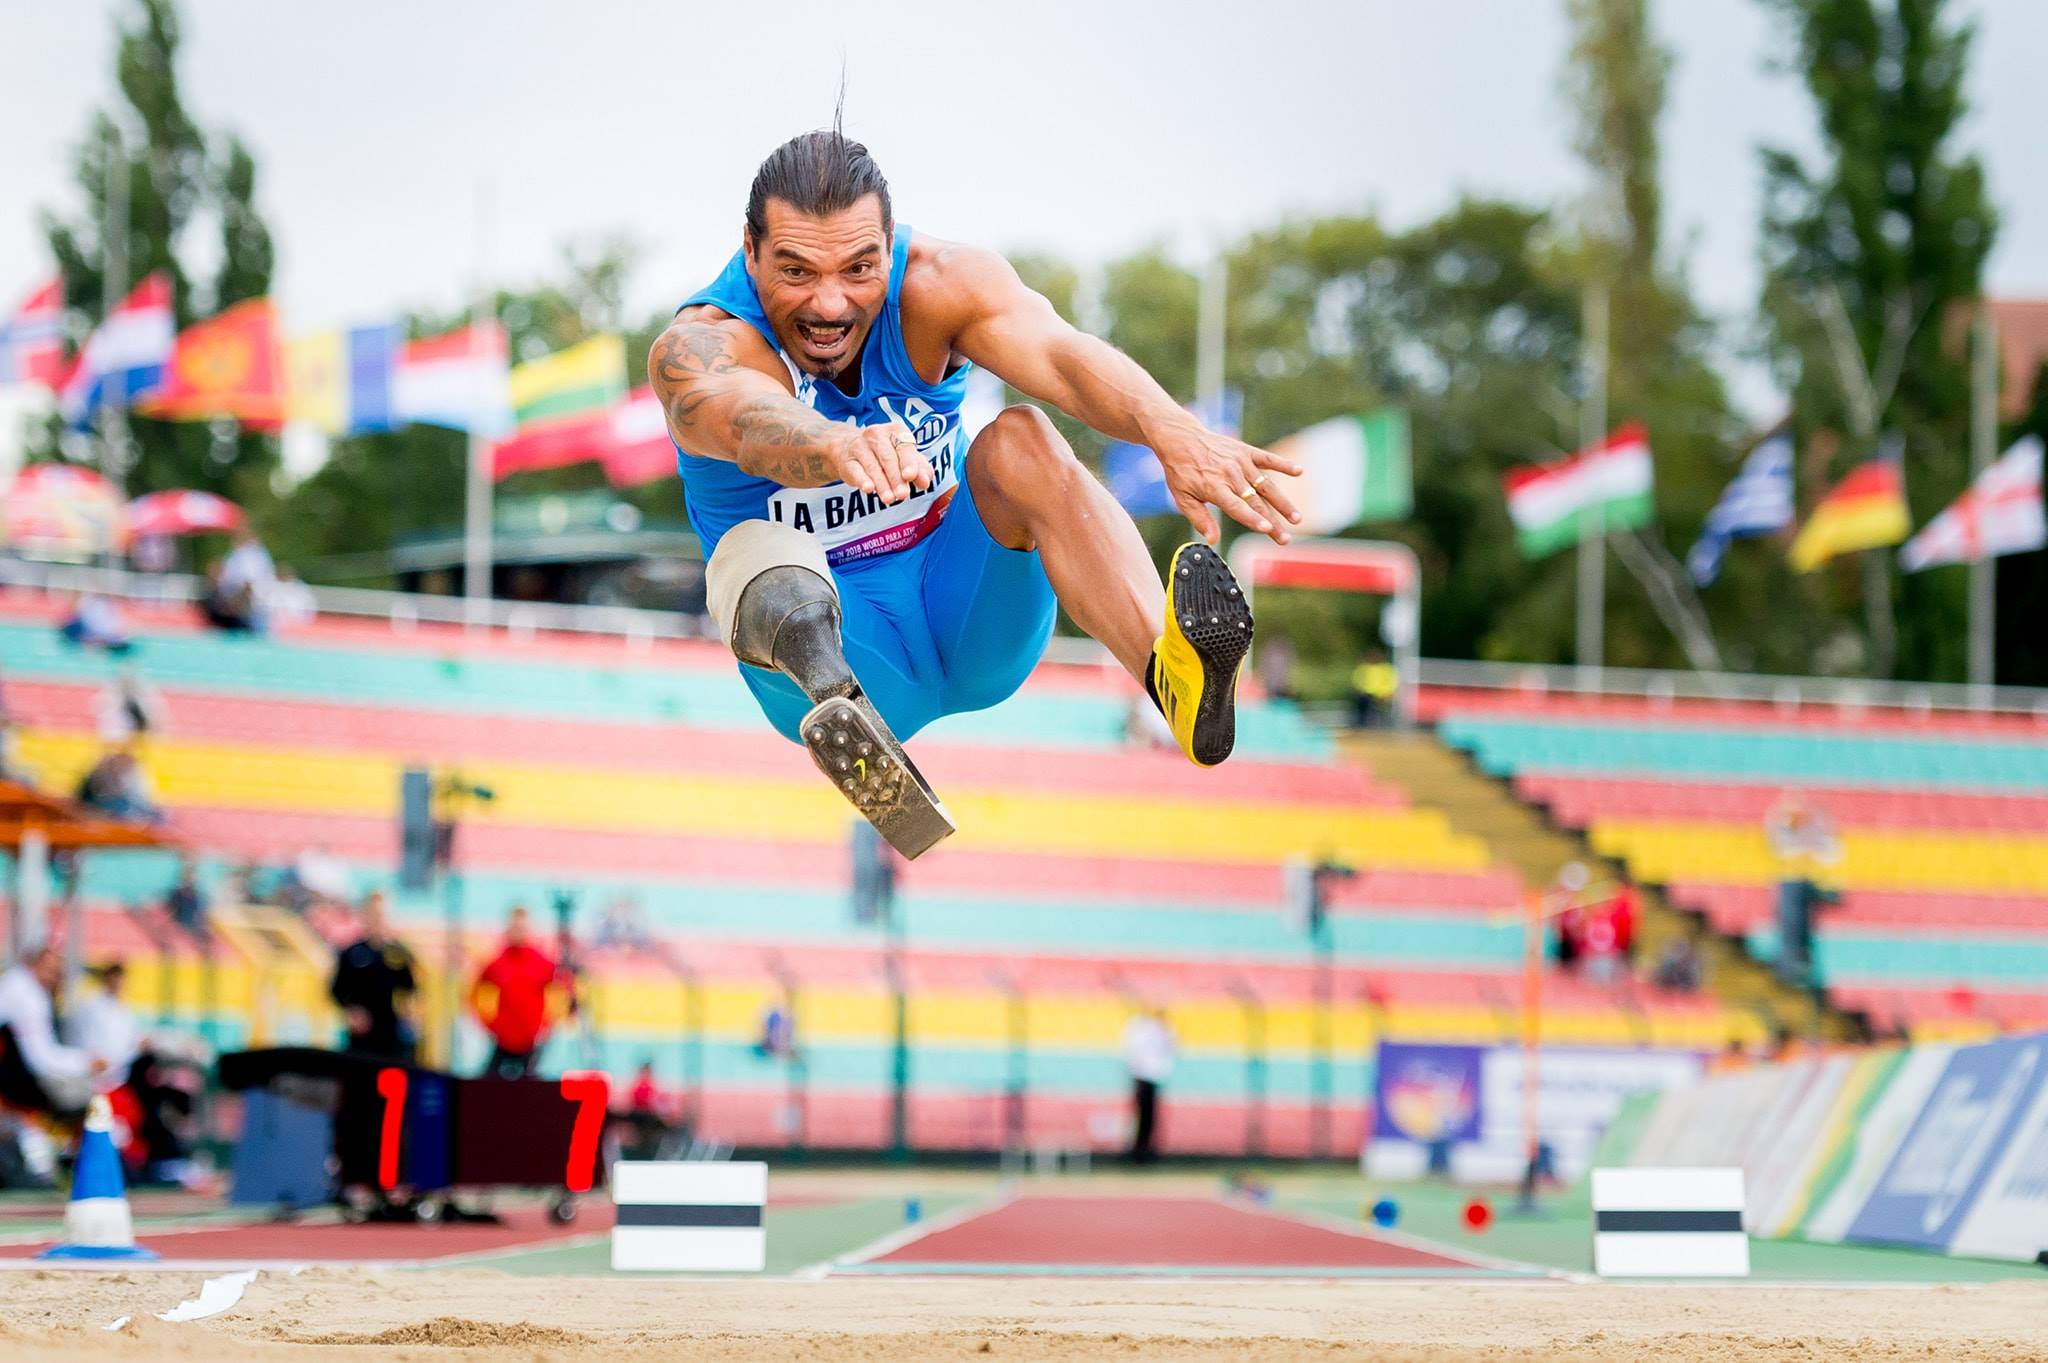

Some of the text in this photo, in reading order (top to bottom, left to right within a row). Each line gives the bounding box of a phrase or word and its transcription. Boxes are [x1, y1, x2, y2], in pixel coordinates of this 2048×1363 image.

[845, 544, 862, 557] 2018
[862, 536, 885, 550] WORLD
[885, 530, 902, 543] PARA
[561, 1070, 613, 1192] 7
